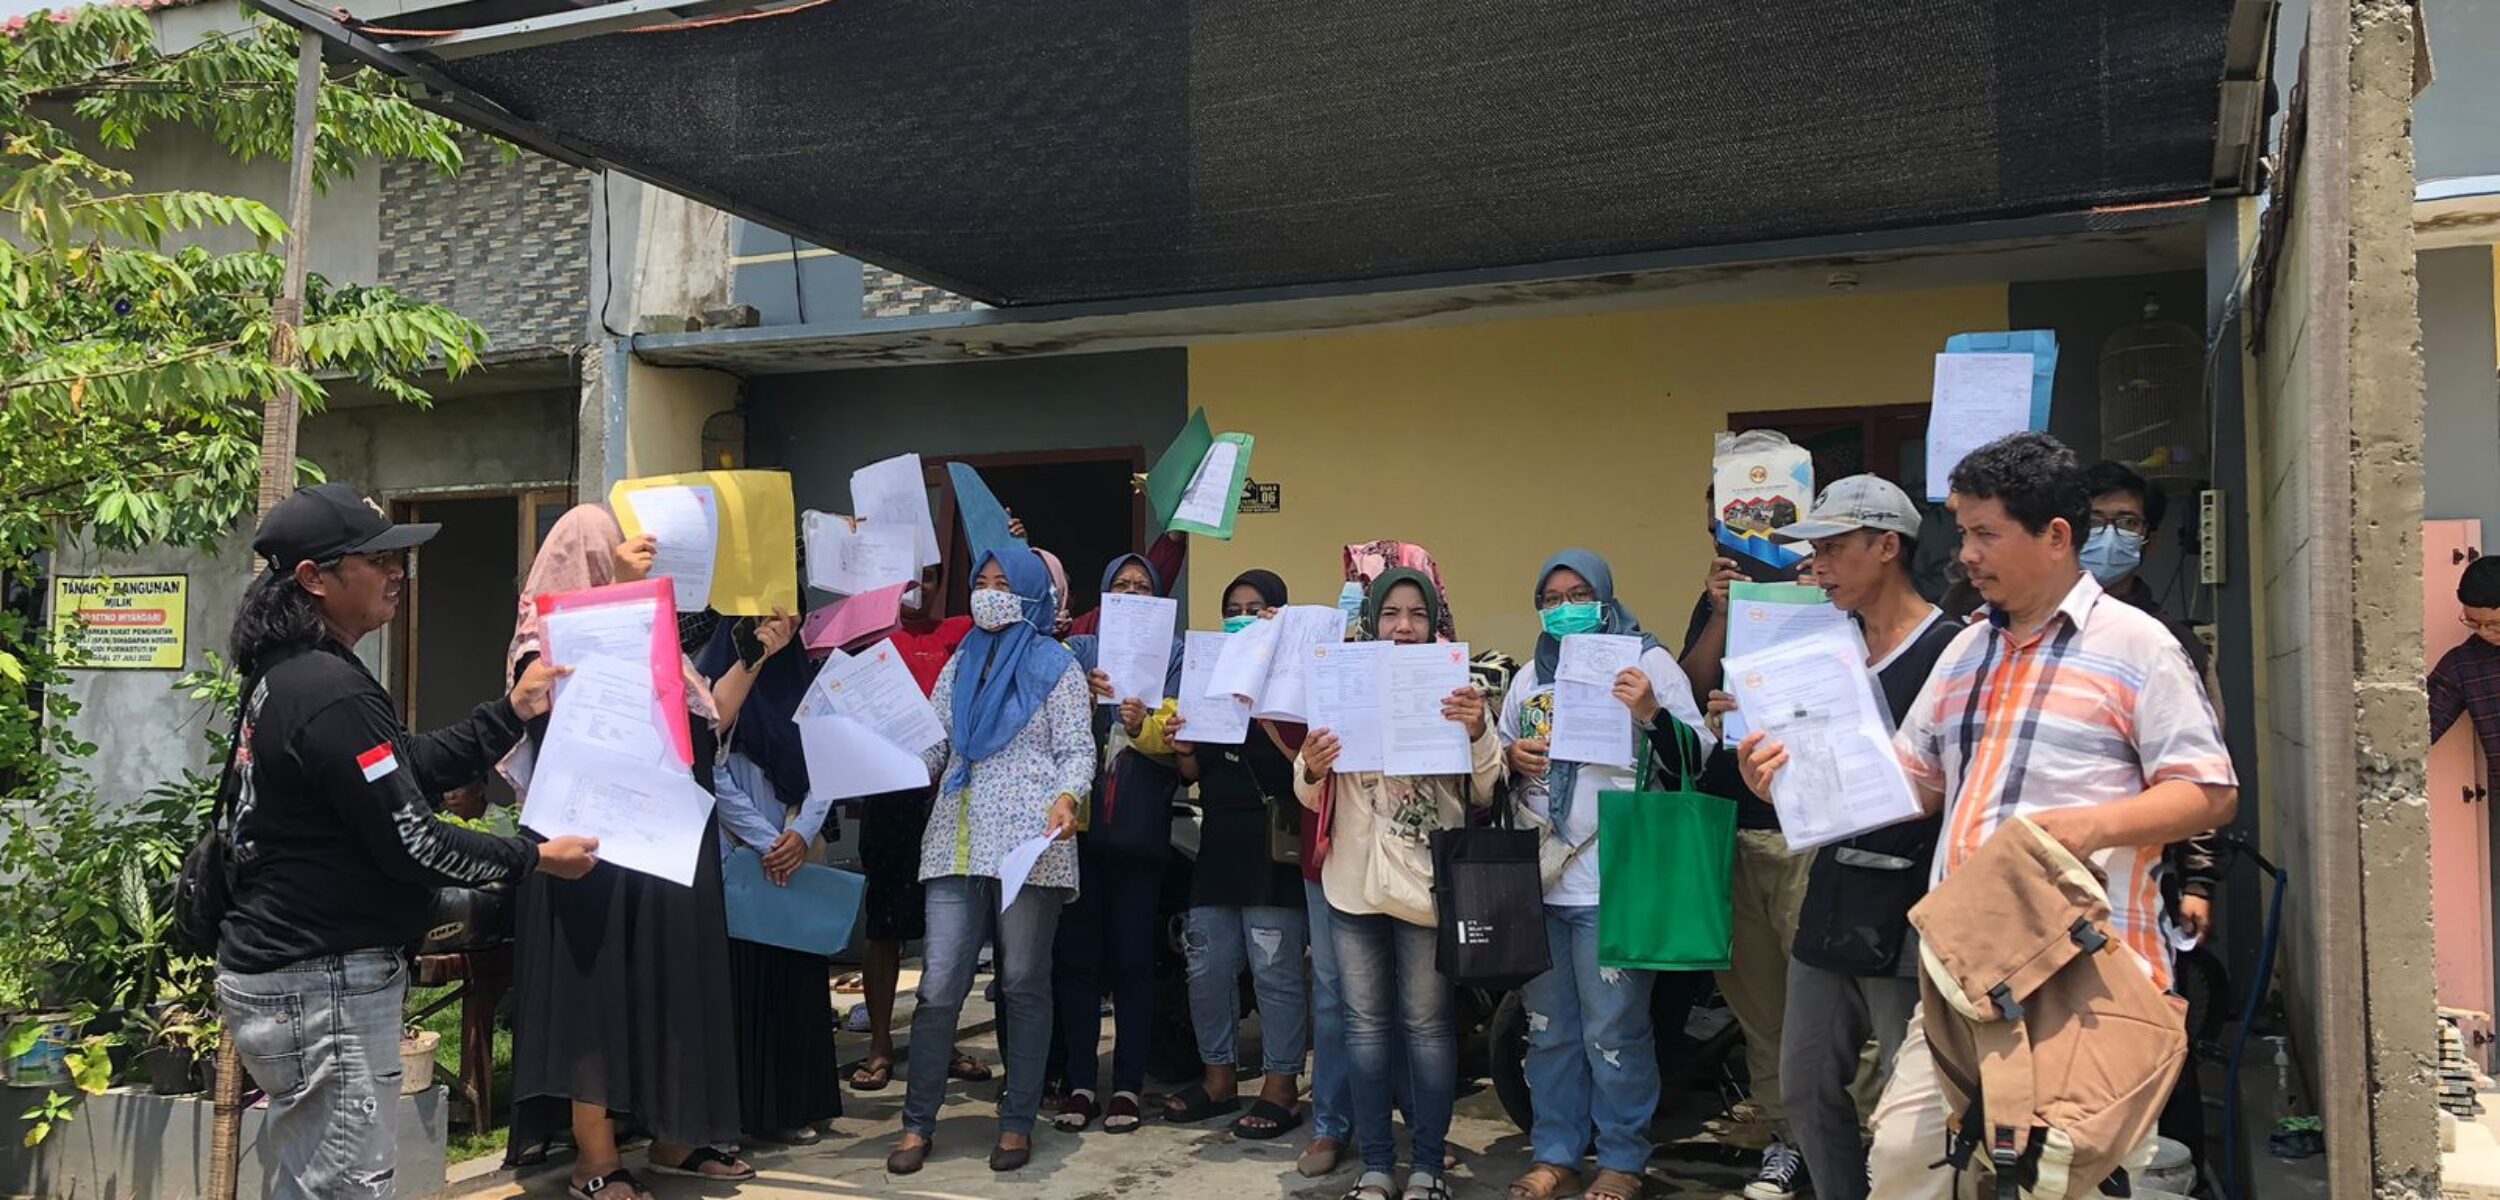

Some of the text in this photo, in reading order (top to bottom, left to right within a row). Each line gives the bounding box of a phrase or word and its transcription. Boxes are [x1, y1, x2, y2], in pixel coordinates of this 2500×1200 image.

[1262, 492, 1275, 503] 06
[62, 582, 98, 594] TANAH
[113, 581, 180, 594] BANGUNAN
[104, 598, 132, 607] MILIK
